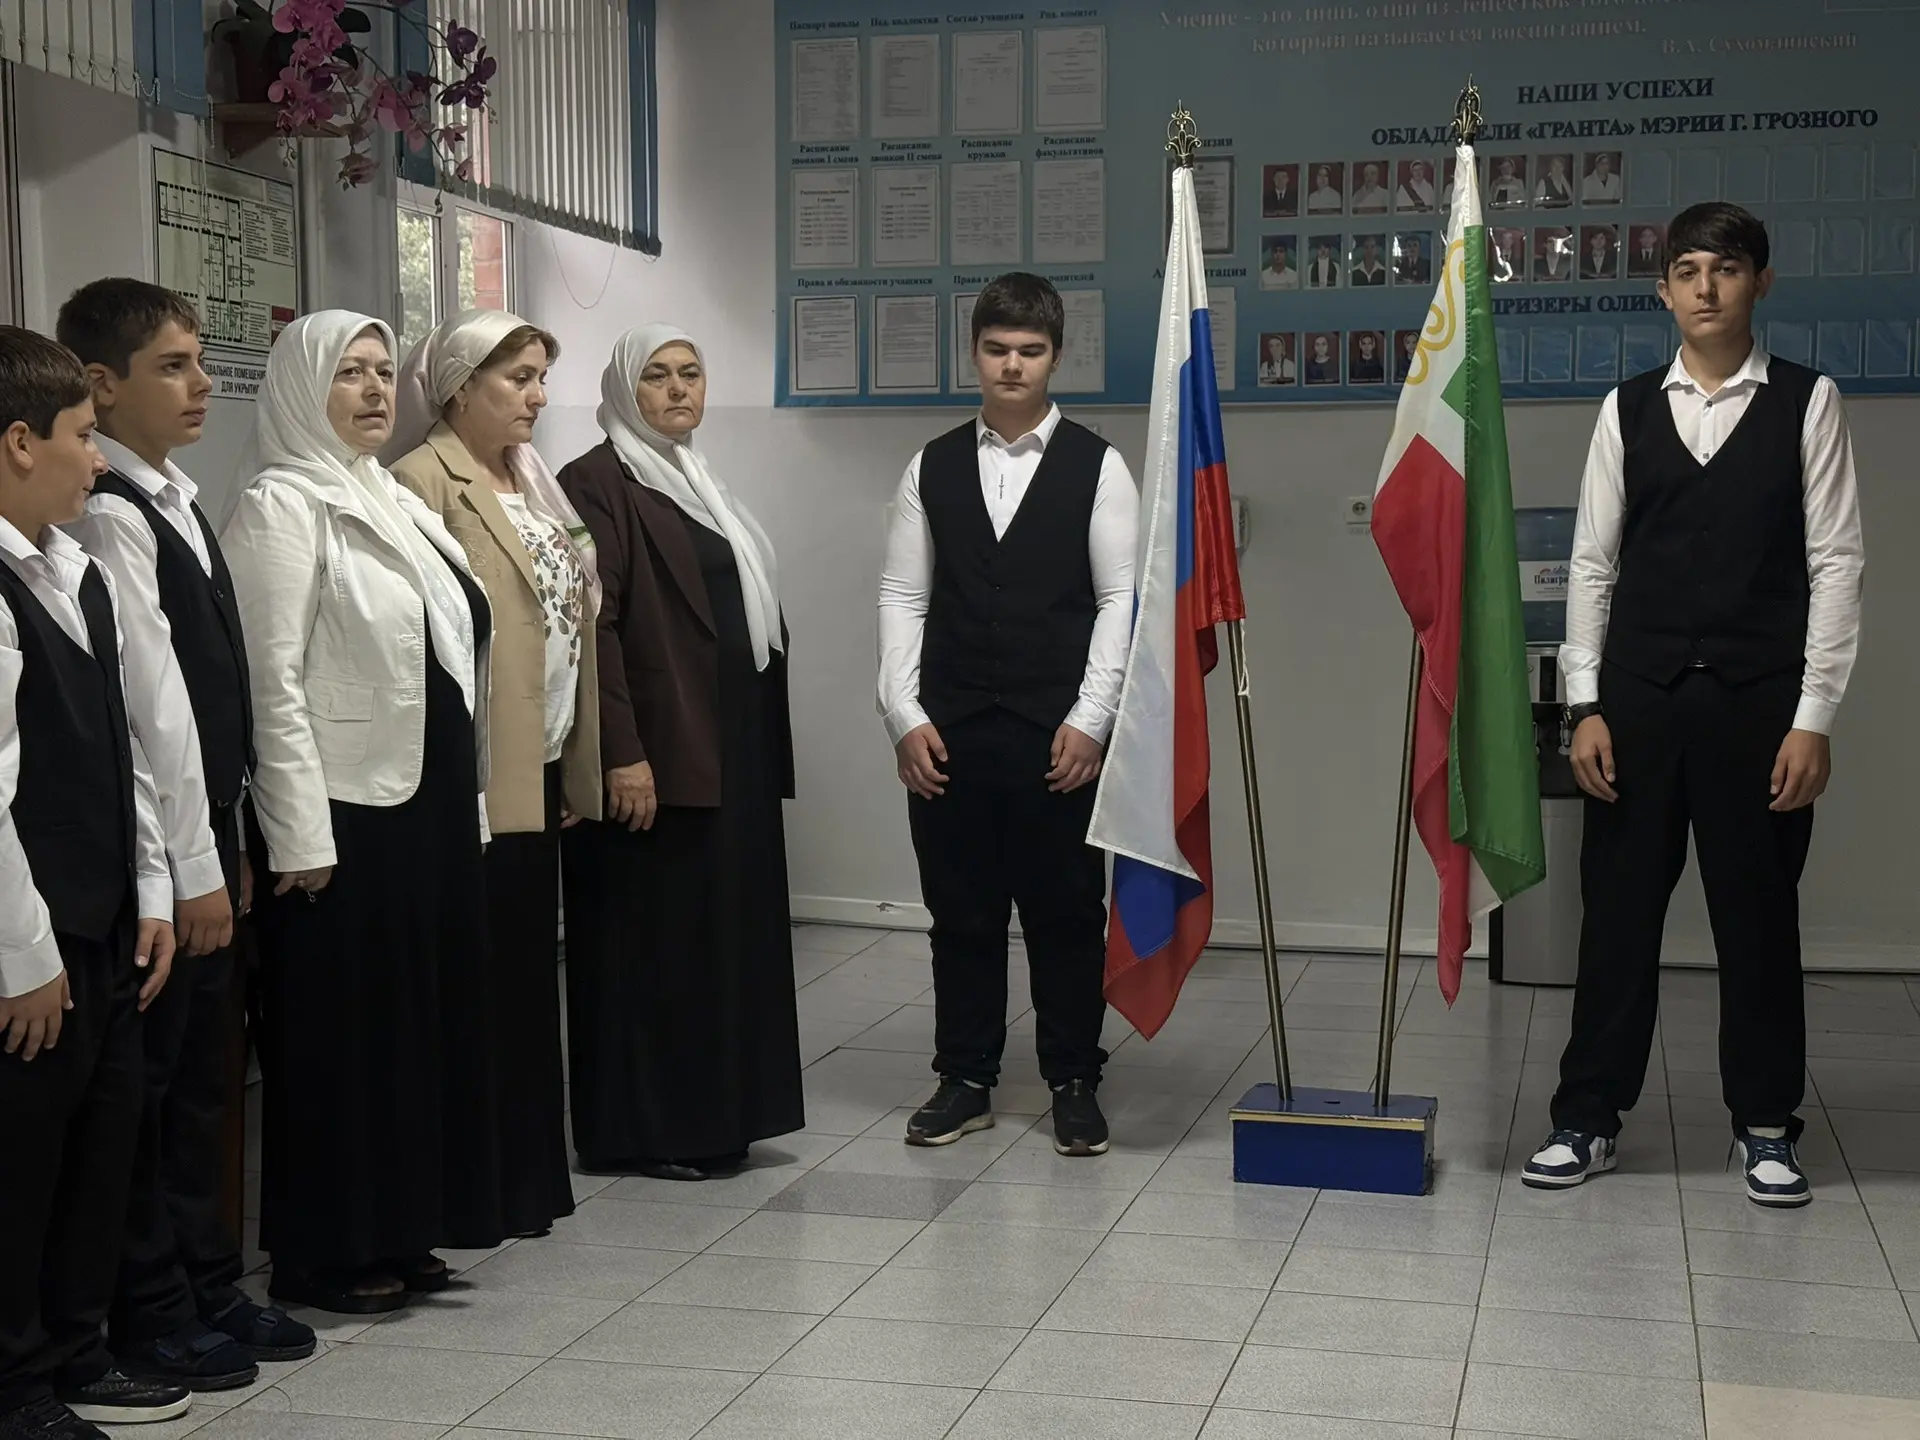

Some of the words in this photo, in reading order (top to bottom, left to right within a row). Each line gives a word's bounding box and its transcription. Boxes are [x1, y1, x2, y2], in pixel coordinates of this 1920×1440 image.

[946, 14, 978, 23] Состав
[1256, 10, 1292, 24] это
[789, 20, 827, 31] Паспорт
[1517, 83, 1598, 105] НАШИ
[1606, 78, 1715, 101] УСПЕХИ
[1371, 122, 1523, 147] ОБЛАДАЕЛИ
[1526, 118, 1636, 141] «ГРАНТА»
[1639, 113, 1725, 135] МЭРИИ
[1729, 113, 1748, 131] Г.
[1753, 109, 1879, 130] ГРОЗНОГО
[960, 139, 1013, 149] Расписание
[1043, 136, 1097, 145] Расписание
[799, 144, 851, 154] Расписание
[880, 142, 933, 151] Расписание
[797, 278, 825, 288] Права
[834, 277, 888, 287] обязанности
[953, 275, 982, 285] Права
[1491, 296, 1592, 315] ПРИЗЕРЫ
[1596, 294, 1668, 313] ОЛИМ
[221, 380, 233, 393] ДЛЯ
[1534, 574, 1569, 586] Пилигри
